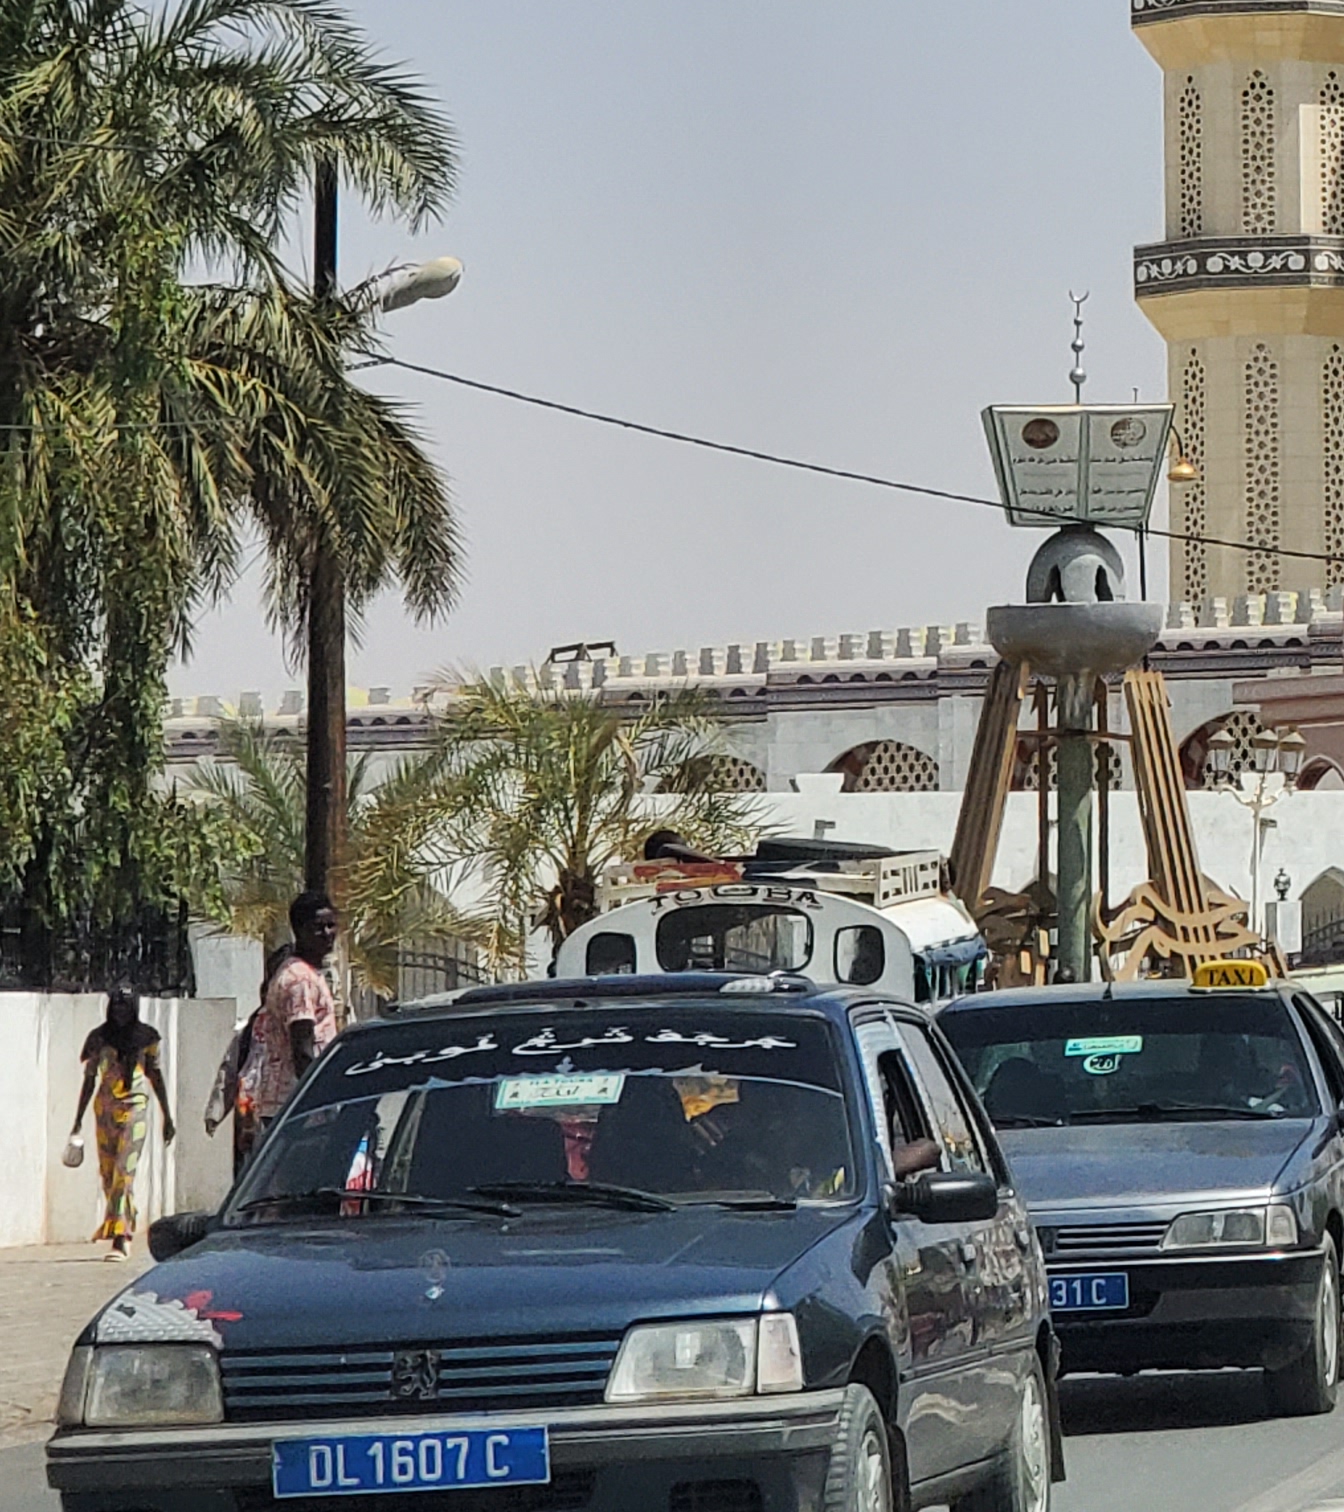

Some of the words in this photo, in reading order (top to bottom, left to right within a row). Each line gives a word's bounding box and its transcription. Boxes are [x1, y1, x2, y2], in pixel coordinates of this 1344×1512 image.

[1207, 968, 1256, 986] TAXI
[1091, 1278, 1106, 1304] C
[308, 1444, 360, 1487] DL
[367, 1437, 469, 1484] 1607
[485, 1434, 510, 1477] C
